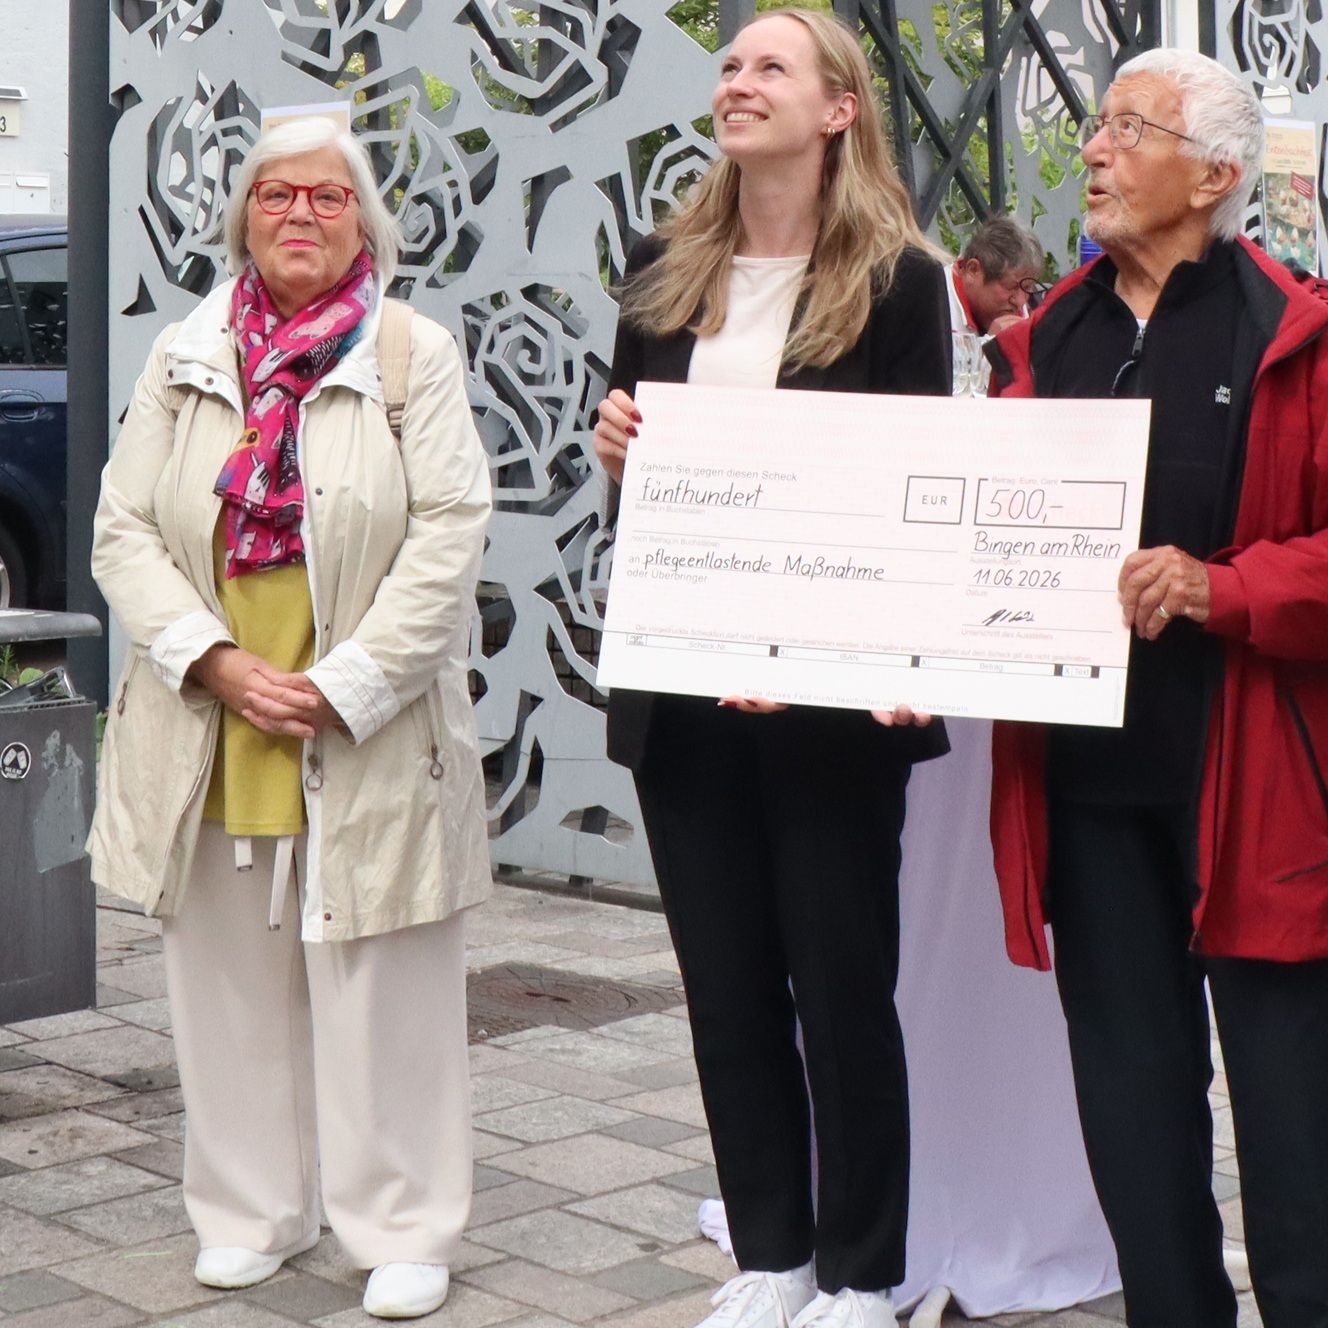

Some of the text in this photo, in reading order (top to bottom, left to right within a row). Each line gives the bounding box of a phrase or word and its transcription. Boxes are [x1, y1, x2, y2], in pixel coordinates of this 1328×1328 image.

[640, 462, 797, 482] Zahlen Sie gegen diesen Scheck
[642, 476, 763, 508] fünfhundert
[921, 495, 948, 506] EUR
[973, 530, 1121, 560] Bingen am Rhein
[628, 555, 641, 563] an
[626, 569, 648, 578] oder
[783, 554, 885, 582] Maßnahme
[973, 568, 1062, 588] 11.06.2026
[965, 589, 988, 597] Datum
[839, 652, 859, 661] IBAN
[979, 662, 1003, 672] Betrag
